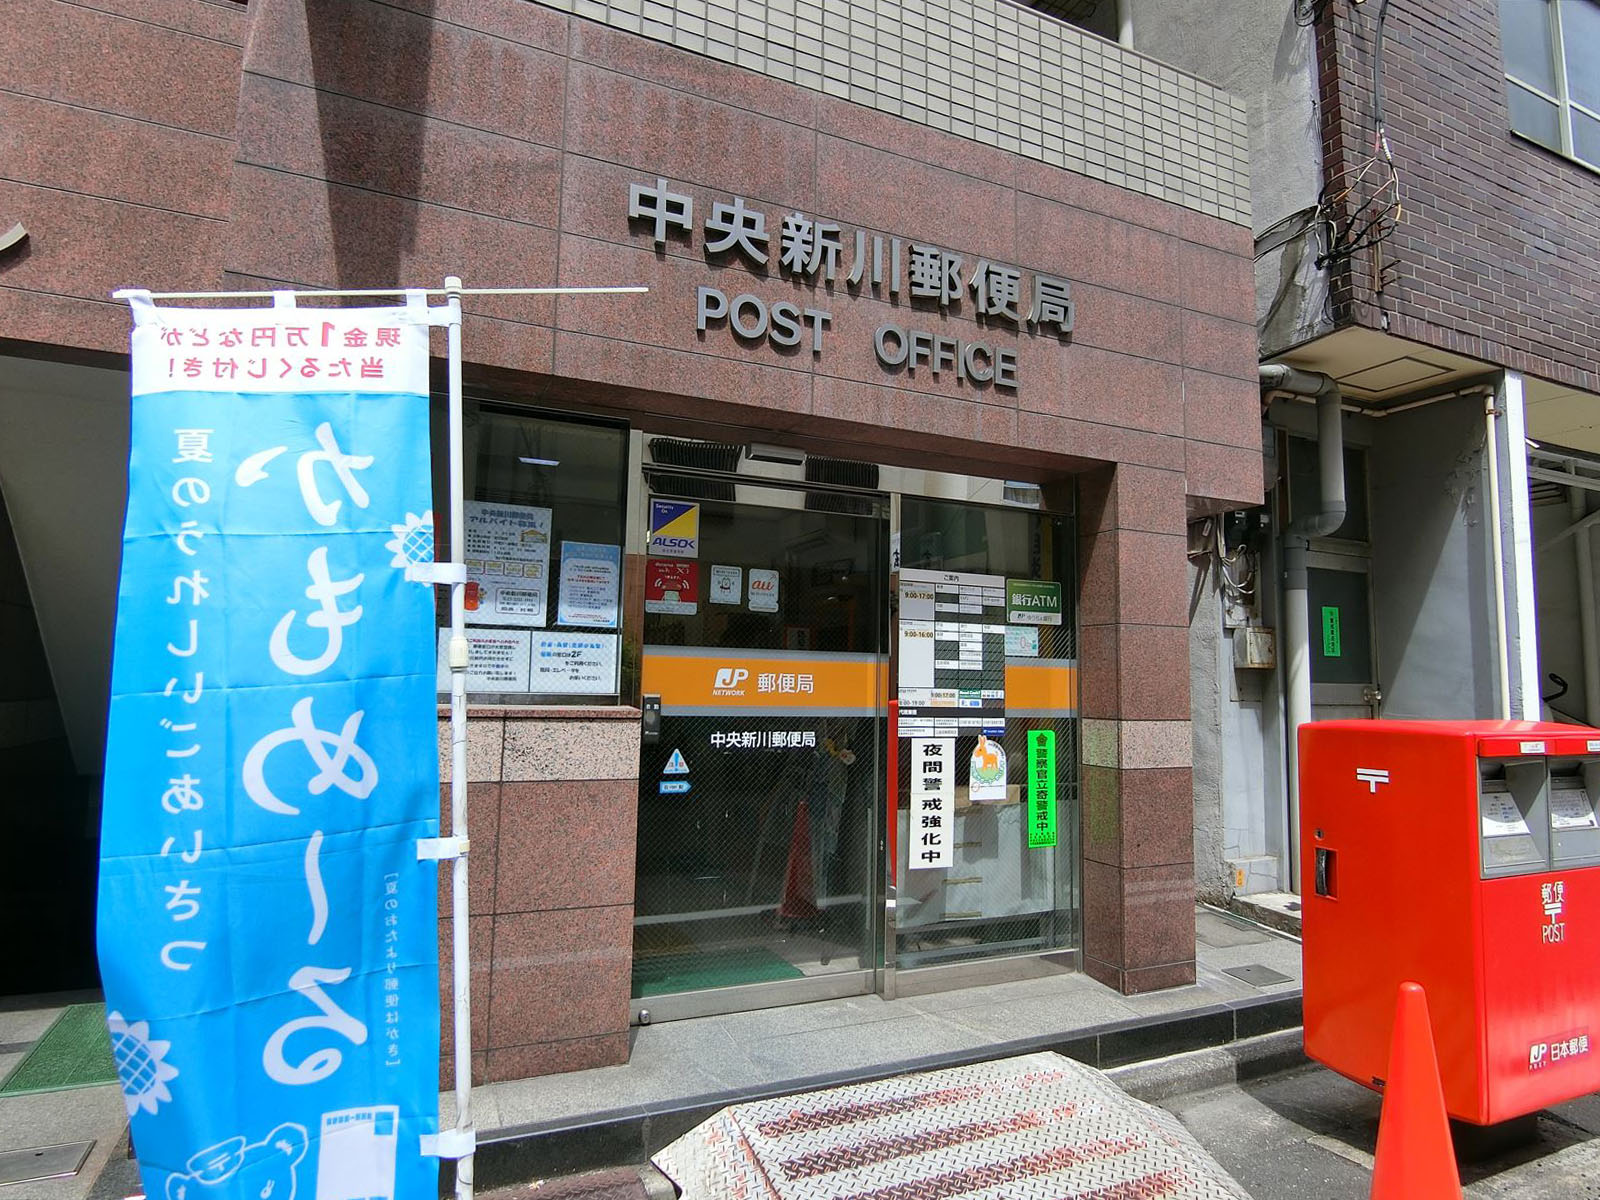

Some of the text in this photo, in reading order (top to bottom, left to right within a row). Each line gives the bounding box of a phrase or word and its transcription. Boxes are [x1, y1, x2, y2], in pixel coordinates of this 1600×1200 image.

[629, 178, 1076, 333] 中央新川郵便局
[697, 287, 1019, 387] POST OFFICE
[652, 537, 695, 549] ALSOK
[752, 580, 774, 591] au
[943, 573, 960, 583] ご案内
[904, 592, 934, 601] 9:00-17:00
[1011, 593, 1058, 608] 銀行ATM
[904, 630, 934, 639] 9:00-16:00
[757, 673, 815, 694] 郵便局
[710, 731, 816, 748] 中央新川郵便局
[921, 744, 943, 863] 夜間警戒強化中
[1541, 881, 1565, 904] 郵便
[1542, 922, 1566, 945] POST
[1550, 1035, 1589, 1062] 日本郵便
